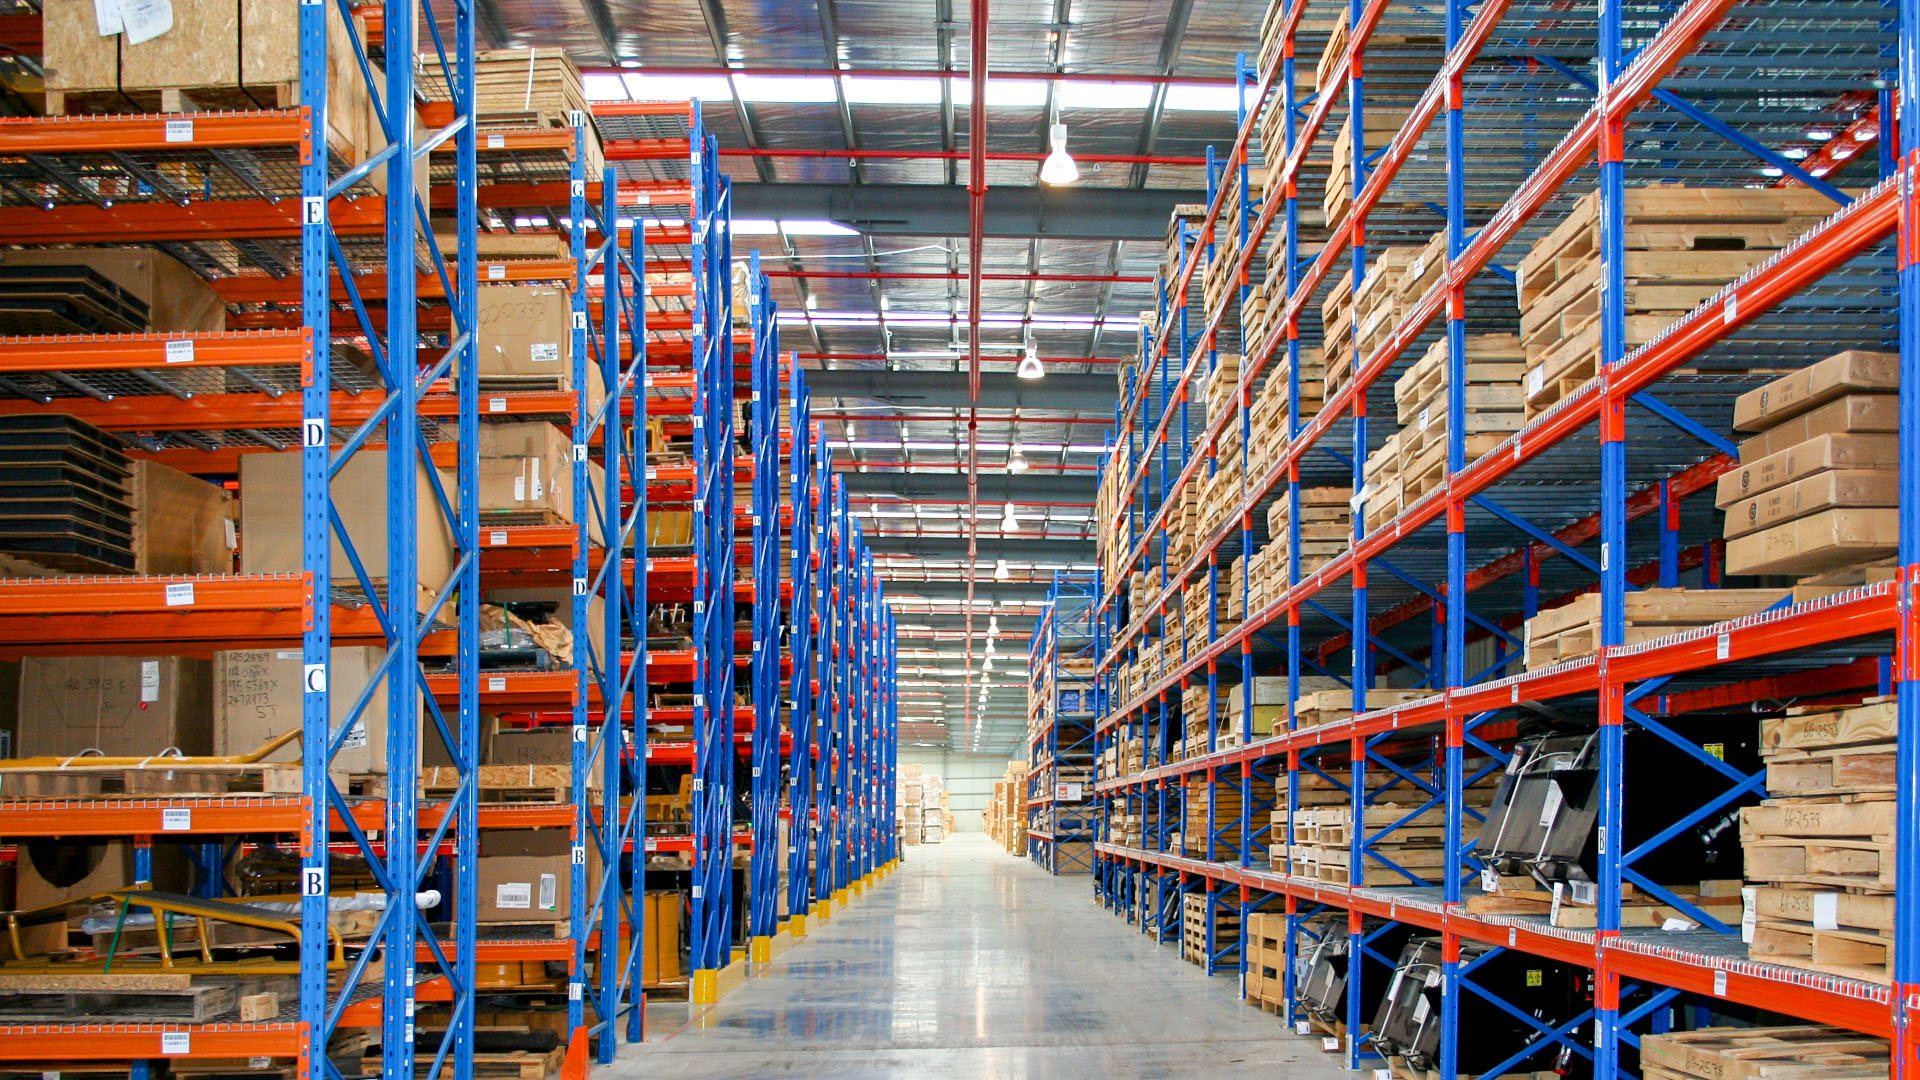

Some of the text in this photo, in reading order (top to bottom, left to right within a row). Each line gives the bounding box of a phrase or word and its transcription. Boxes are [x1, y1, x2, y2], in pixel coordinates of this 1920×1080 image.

[571, 112, 581, 127] H
[572, 182, 583, 197] G
[305, 201, 322, 224] E
[575, 314, 584, 328] F
[306, 423, 323, 446] D
[1602, 545, 1608, 568] C
[575, 581, 586, 595] D
[695, 603, 703, 613] D
[307, 668, 325, 692] C
[695, 696, 702, 706] C
[575, 727, 585, 742] C
[695, 780, 702, 791] B
[1599, 829, 1605, 851] B
[575, 849, 584, 864] B
[305, 872, 322, 895] B
